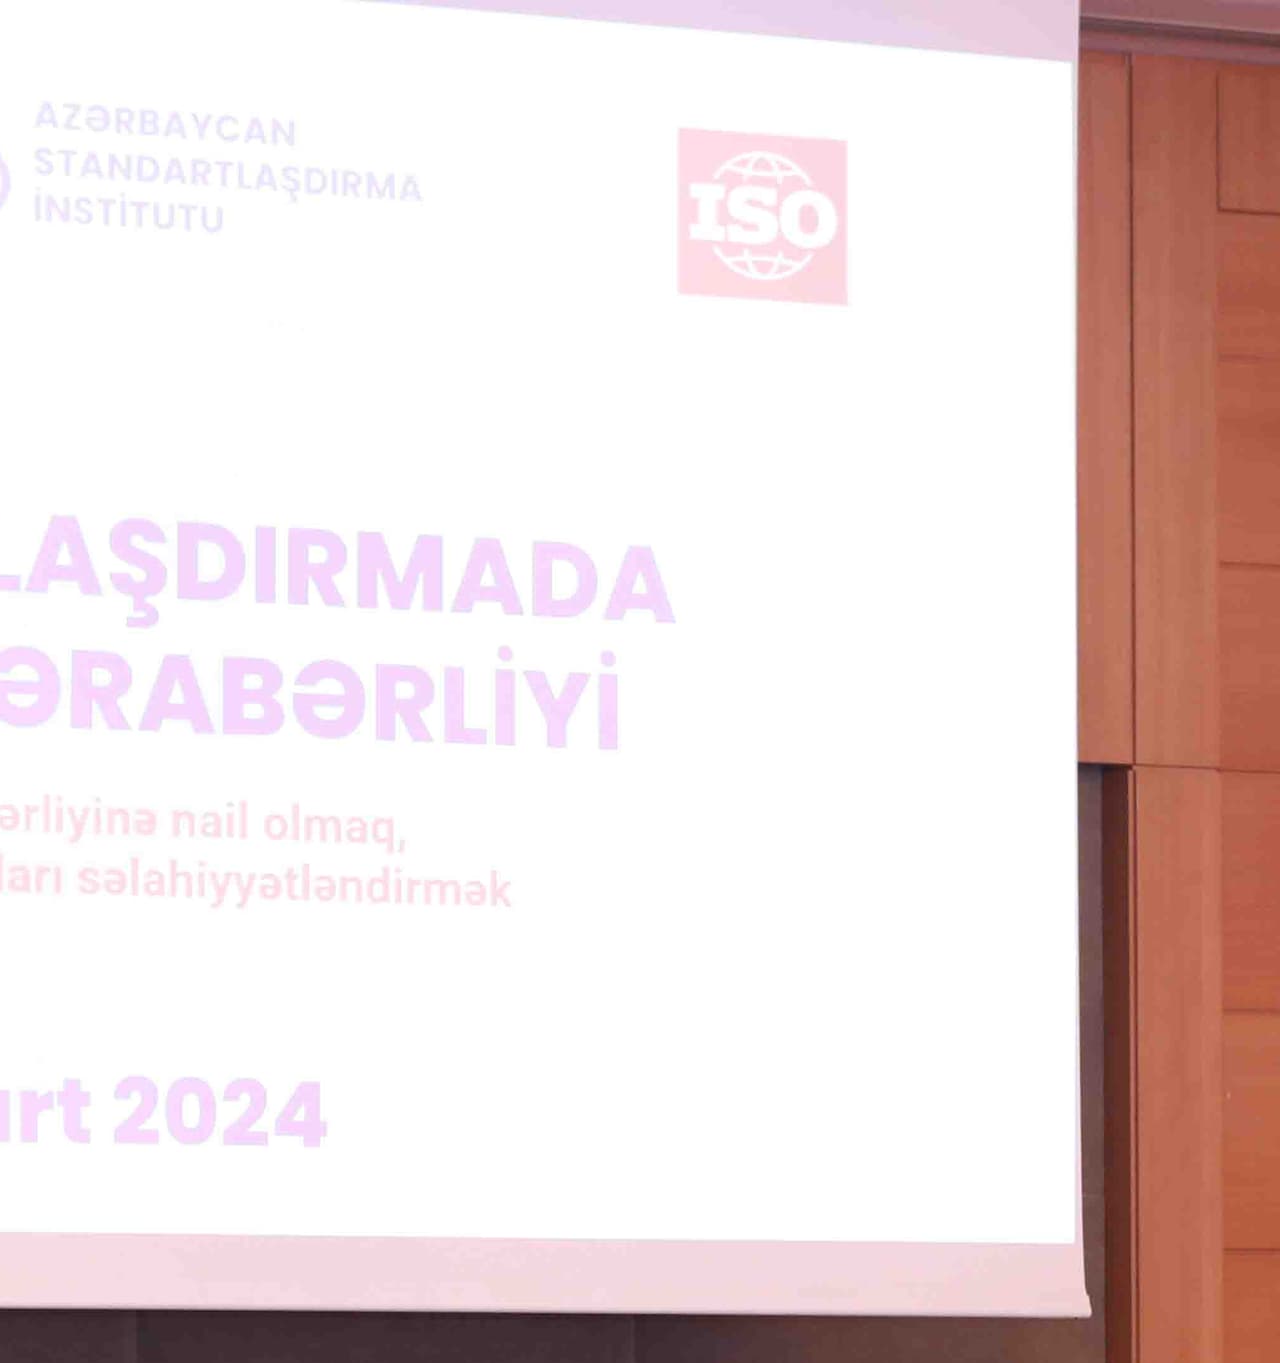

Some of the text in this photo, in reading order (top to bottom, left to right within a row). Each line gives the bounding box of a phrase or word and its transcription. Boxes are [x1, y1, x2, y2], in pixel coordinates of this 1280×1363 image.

[33, 101, 297, 147] AZƏRBAYCAN
[33, 147, 423, 203] STANDARTLAŞDIRMA
[34, 188, 226, 233] İNSTİTUTU
[688, 182, 838, 249] ISO
[170, 802, 248, 842] nail
[263, 804, 407, 856] olmaq,
[77, 859, 513, 910] səlahiyyətləndirmək
[113, 1075, 328, 1149] 2024
